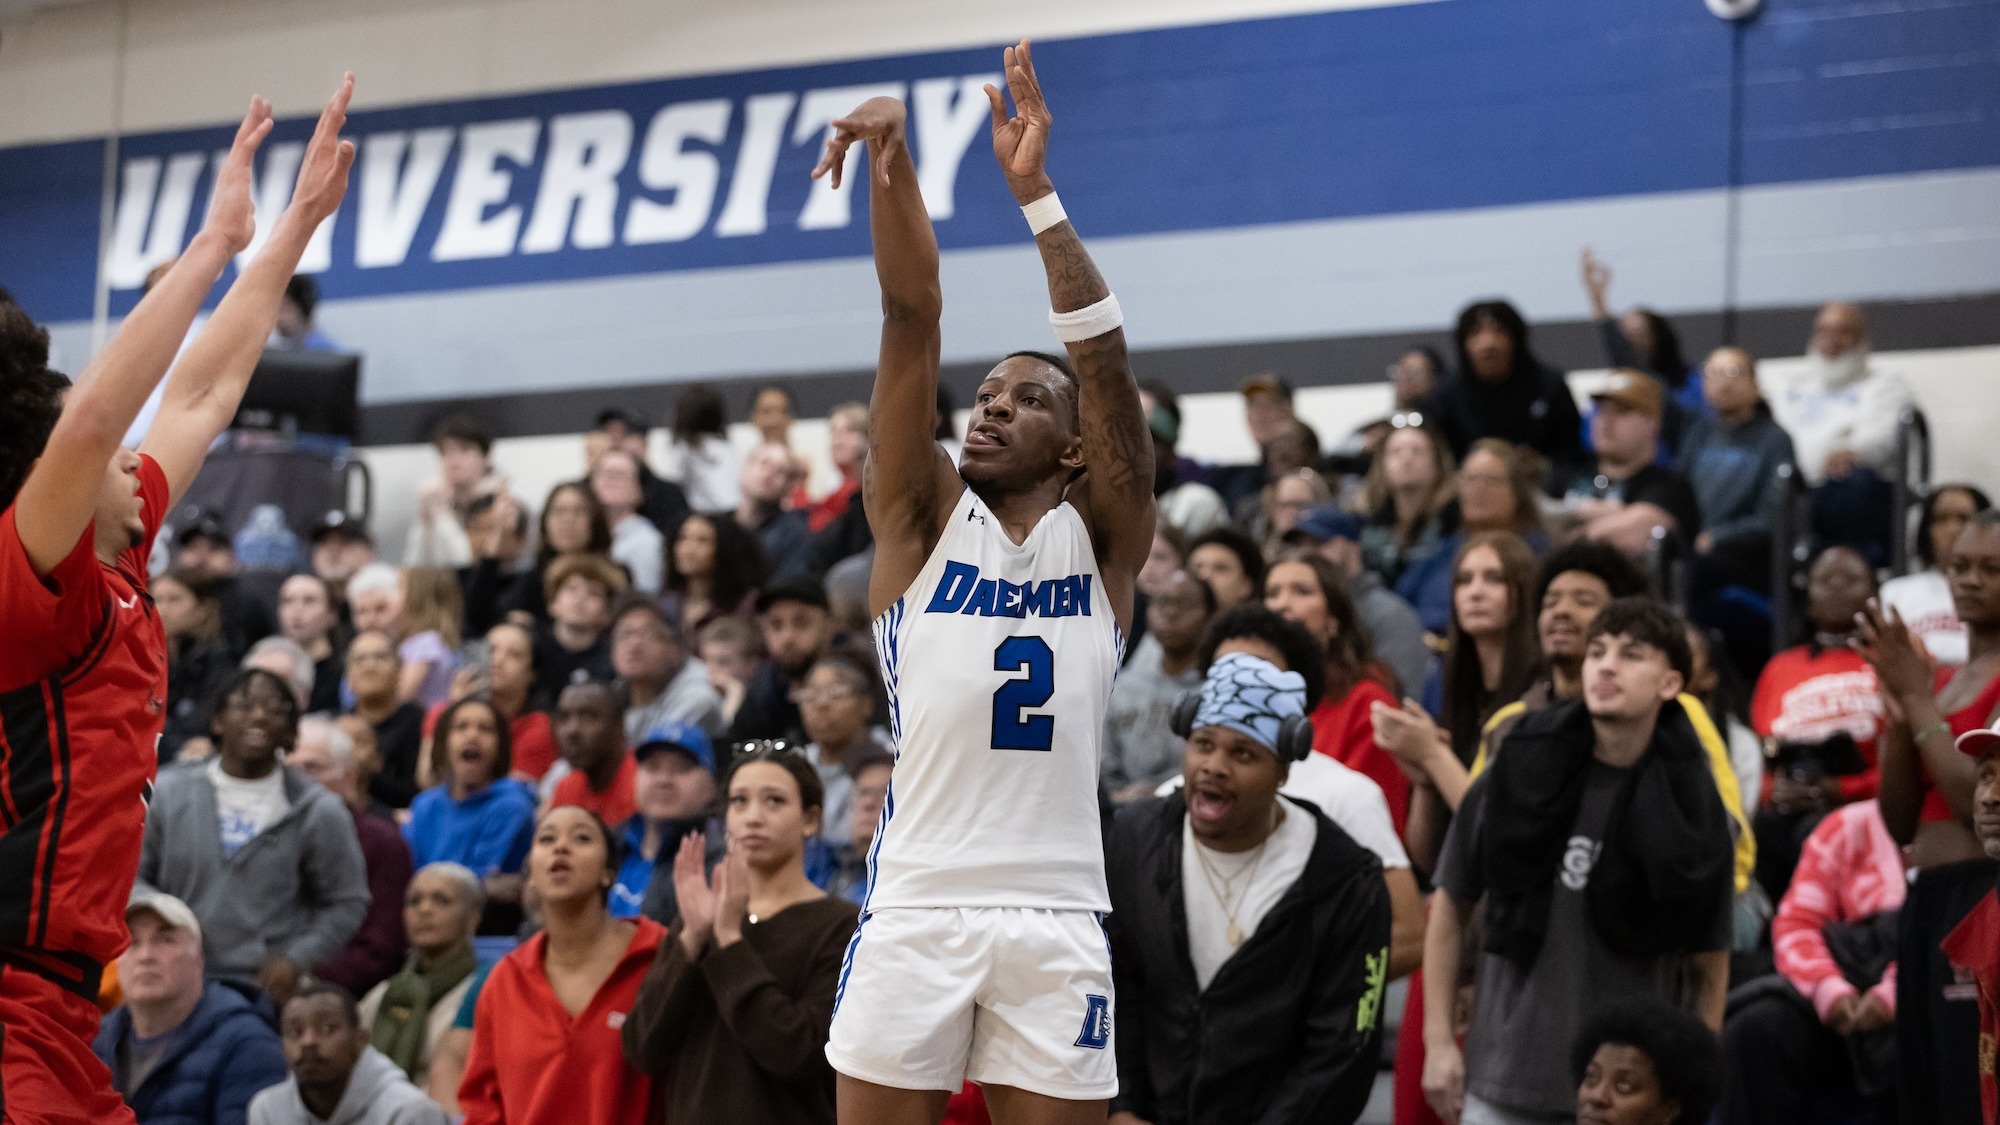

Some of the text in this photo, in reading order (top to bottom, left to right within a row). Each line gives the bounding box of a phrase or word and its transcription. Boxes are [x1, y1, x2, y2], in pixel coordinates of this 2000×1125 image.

[924, 559, 1092, 619] DAEMEN
[990, 635, 1055, 752] 2
[1073, 994, 1109, 1049] D
